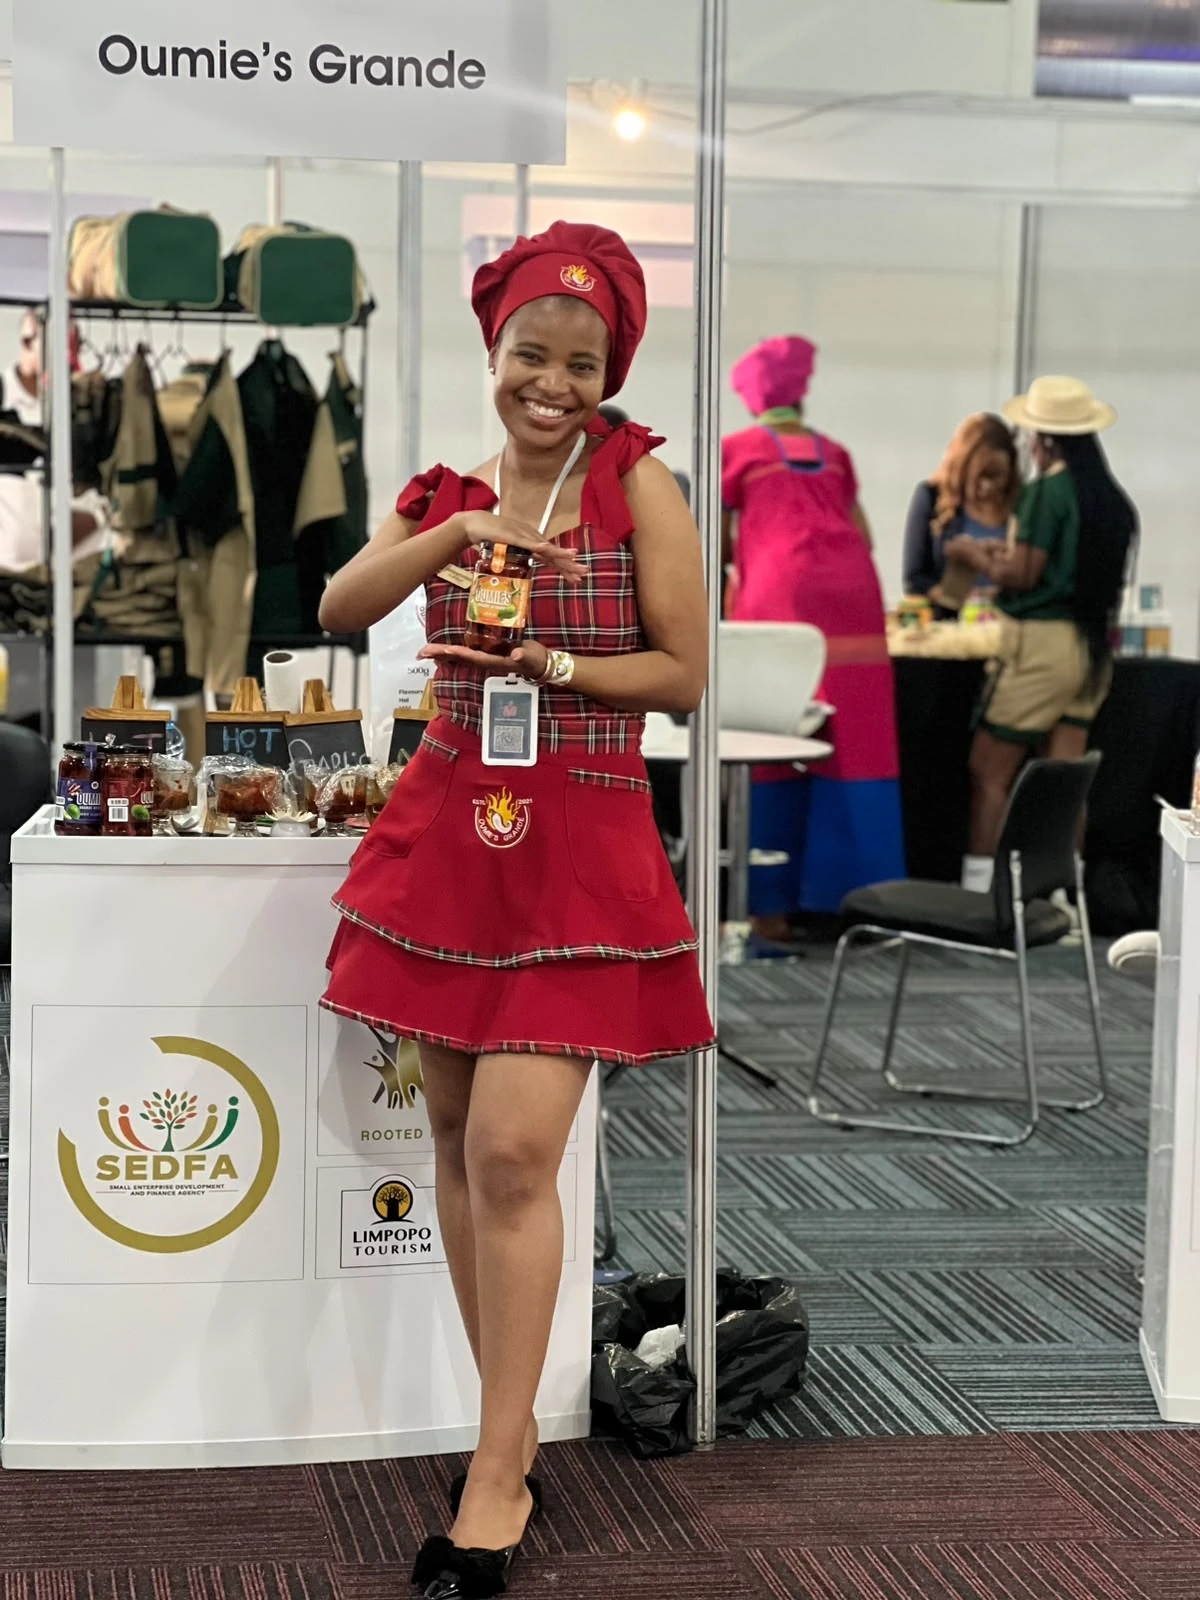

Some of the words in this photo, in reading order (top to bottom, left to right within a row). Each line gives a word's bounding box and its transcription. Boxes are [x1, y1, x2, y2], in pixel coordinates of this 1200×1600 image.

[98, 34, 292, 82] Oumie's
[308, 43, 487, 90] Grande
[407, 666, 431, 677] 500g
[222, 725, 283, 754] HOT
[360, 1128, 424, 1141] ROOTED
[95, 1154, 239, 1182] SEDFA
[352, 1227, 432, 1244] LIMPOPO
[354, 1243, 432, 1257] TOURISM
